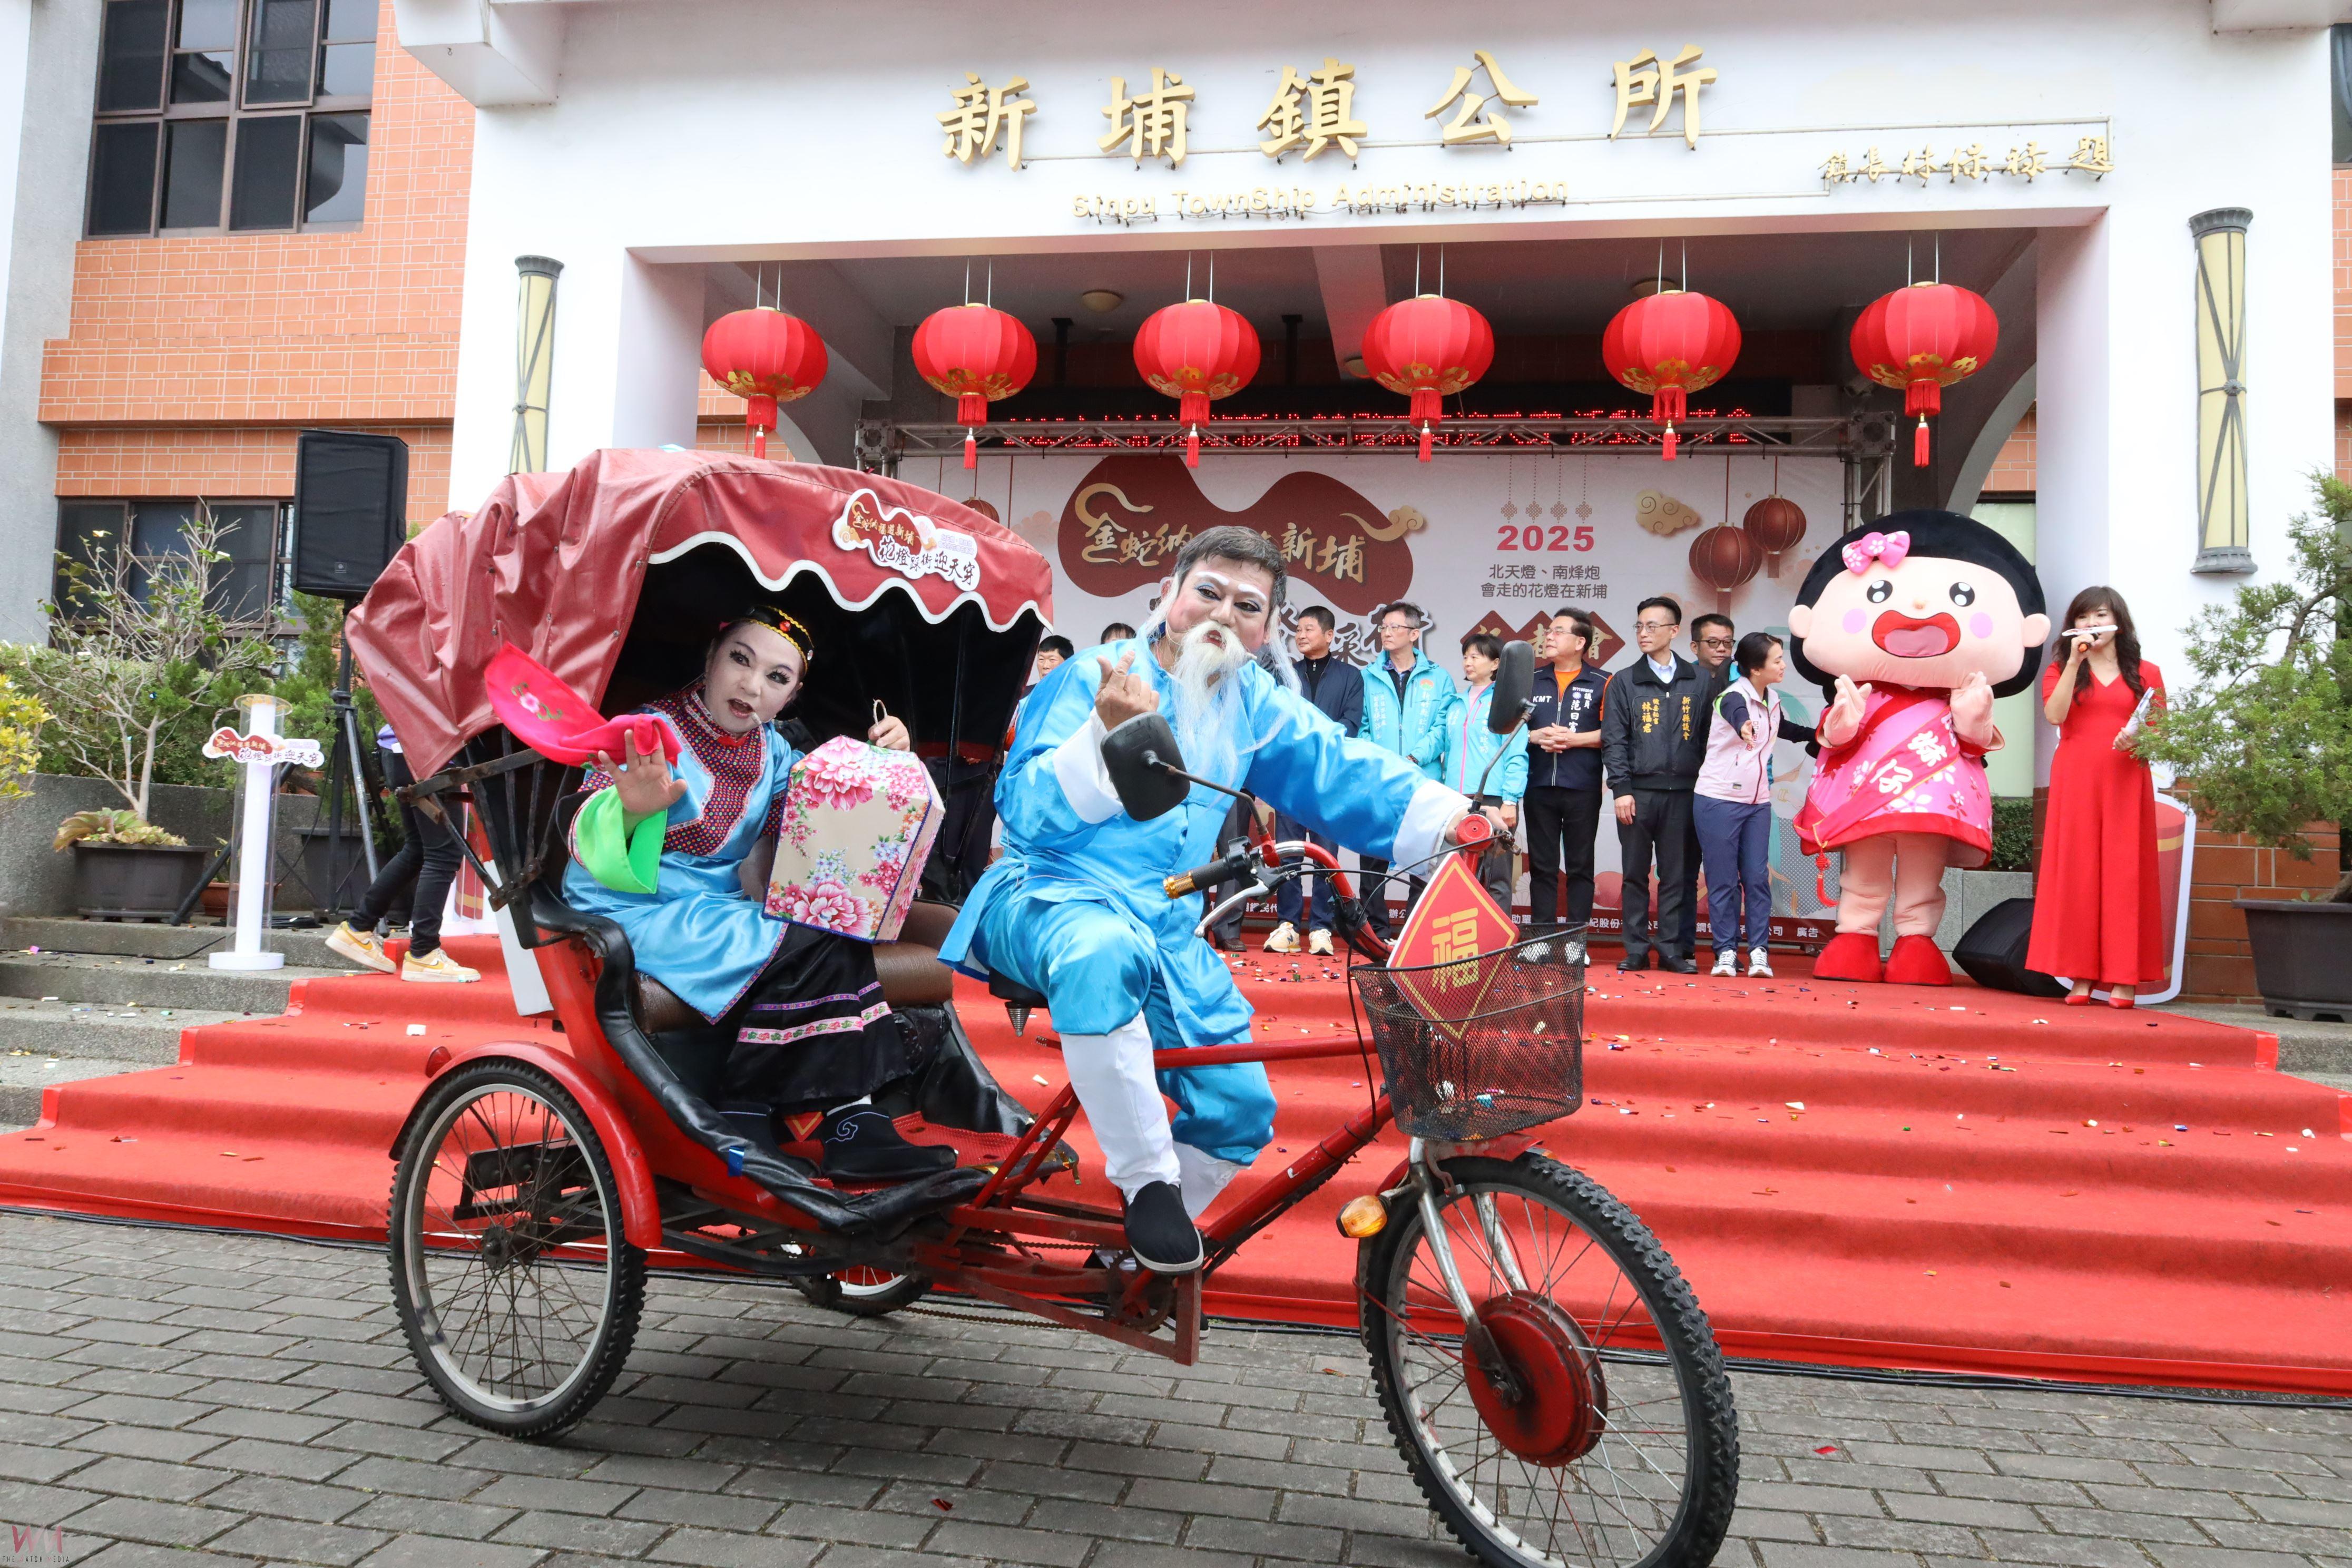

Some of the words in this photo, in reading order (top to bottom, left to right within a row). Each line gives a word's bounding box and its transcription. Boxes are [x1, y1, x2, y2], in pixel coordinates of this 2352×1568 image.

[936, 44, 1718, 170] 新埔鎮公所
[1072, 192, 1157, 217] Sinpu
[1332, 177, 1569, 208] Administration
[1082, 513, 1365, 583] 金蛇納新埔
[1497, 525, 1595, 552] 2025
[879, 536, 975, 585] 花燈踩街迎天穿
[1489, 564, 1601, 581] 北天燈、南烽炮
[1481, 583, 1608, 600] 會走的花燈在新埔
[1533, 695, 1552, 703] KMT
[1869, 713, 1957, 795] 妹仔
[1589, 917, 1623, 929] 紀股份
[1797, 927, 1819, 938] 廣告
[1431, 907, 1479, 994] 福
